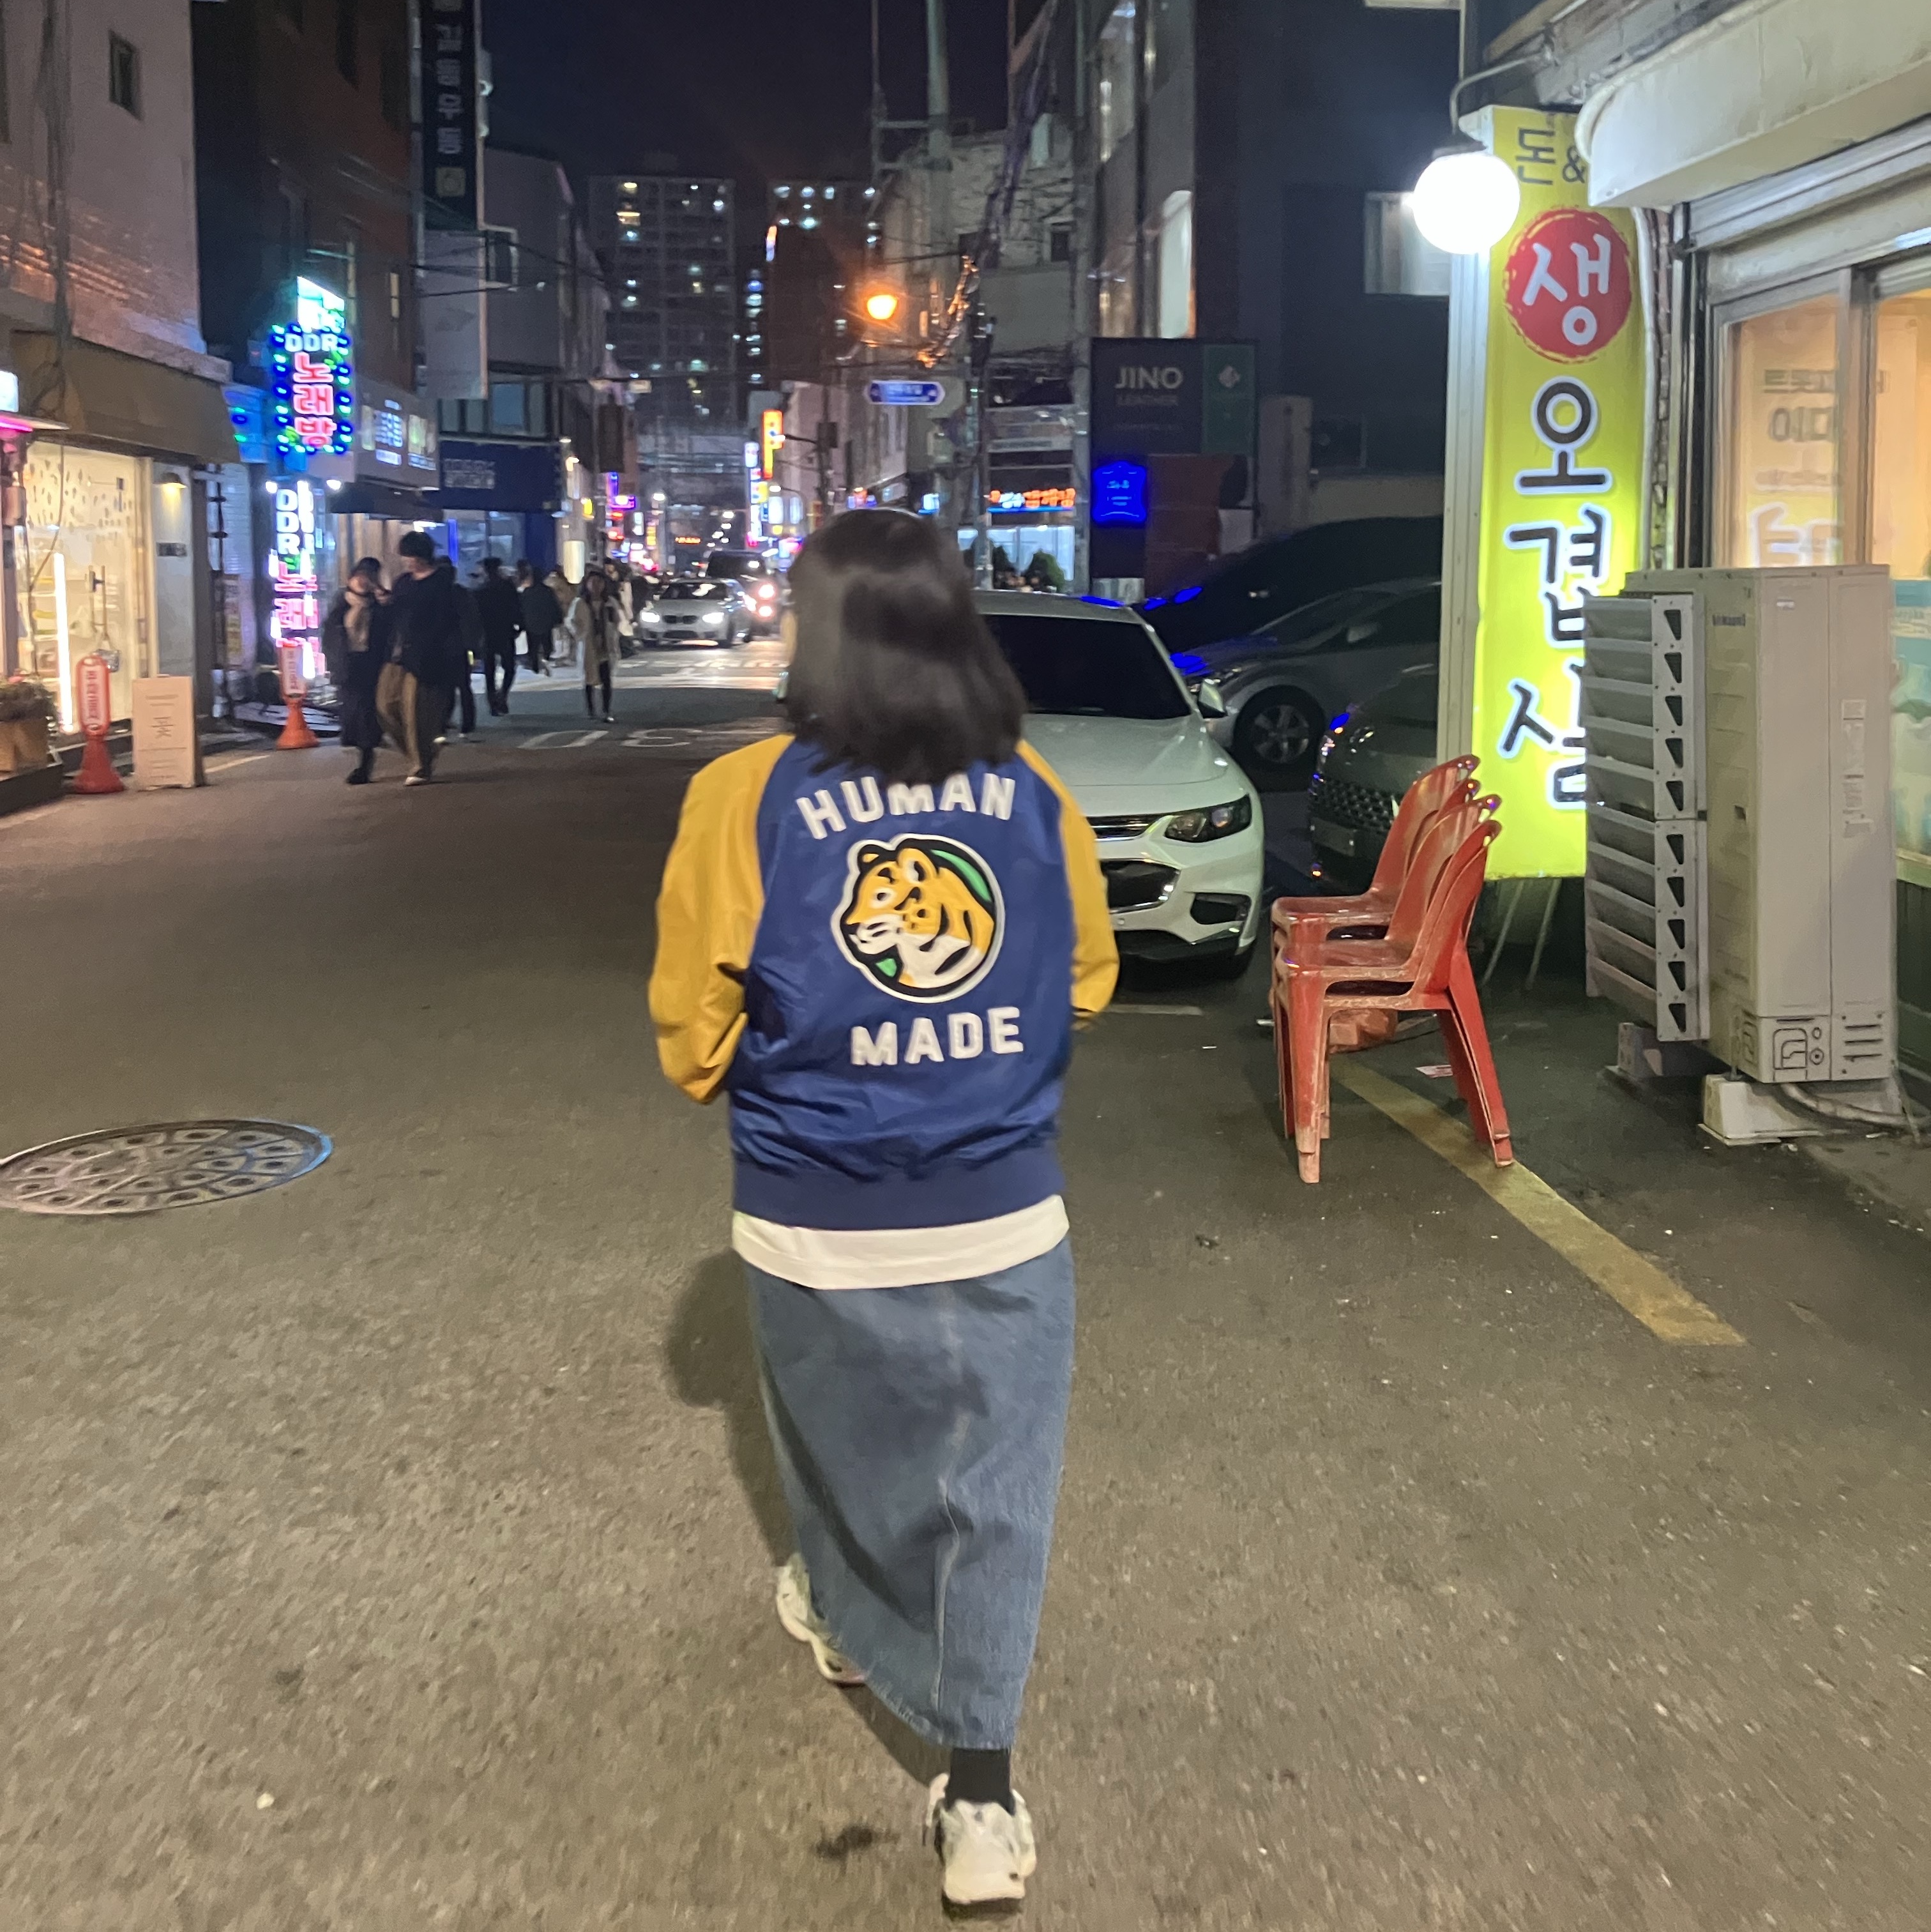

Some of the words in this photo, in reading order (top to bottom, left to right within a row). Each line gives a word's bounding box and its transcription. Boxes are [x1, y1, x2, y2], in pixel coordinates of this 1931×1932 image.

[284, 333, 339, 352] DDR
[292, 351, 337, 447] 노래방
[1115, 366, 1183, 390] JINO
[796, 772, 1016, 839] HUMAN
[851, 1007, 1024, 1066] MADE
